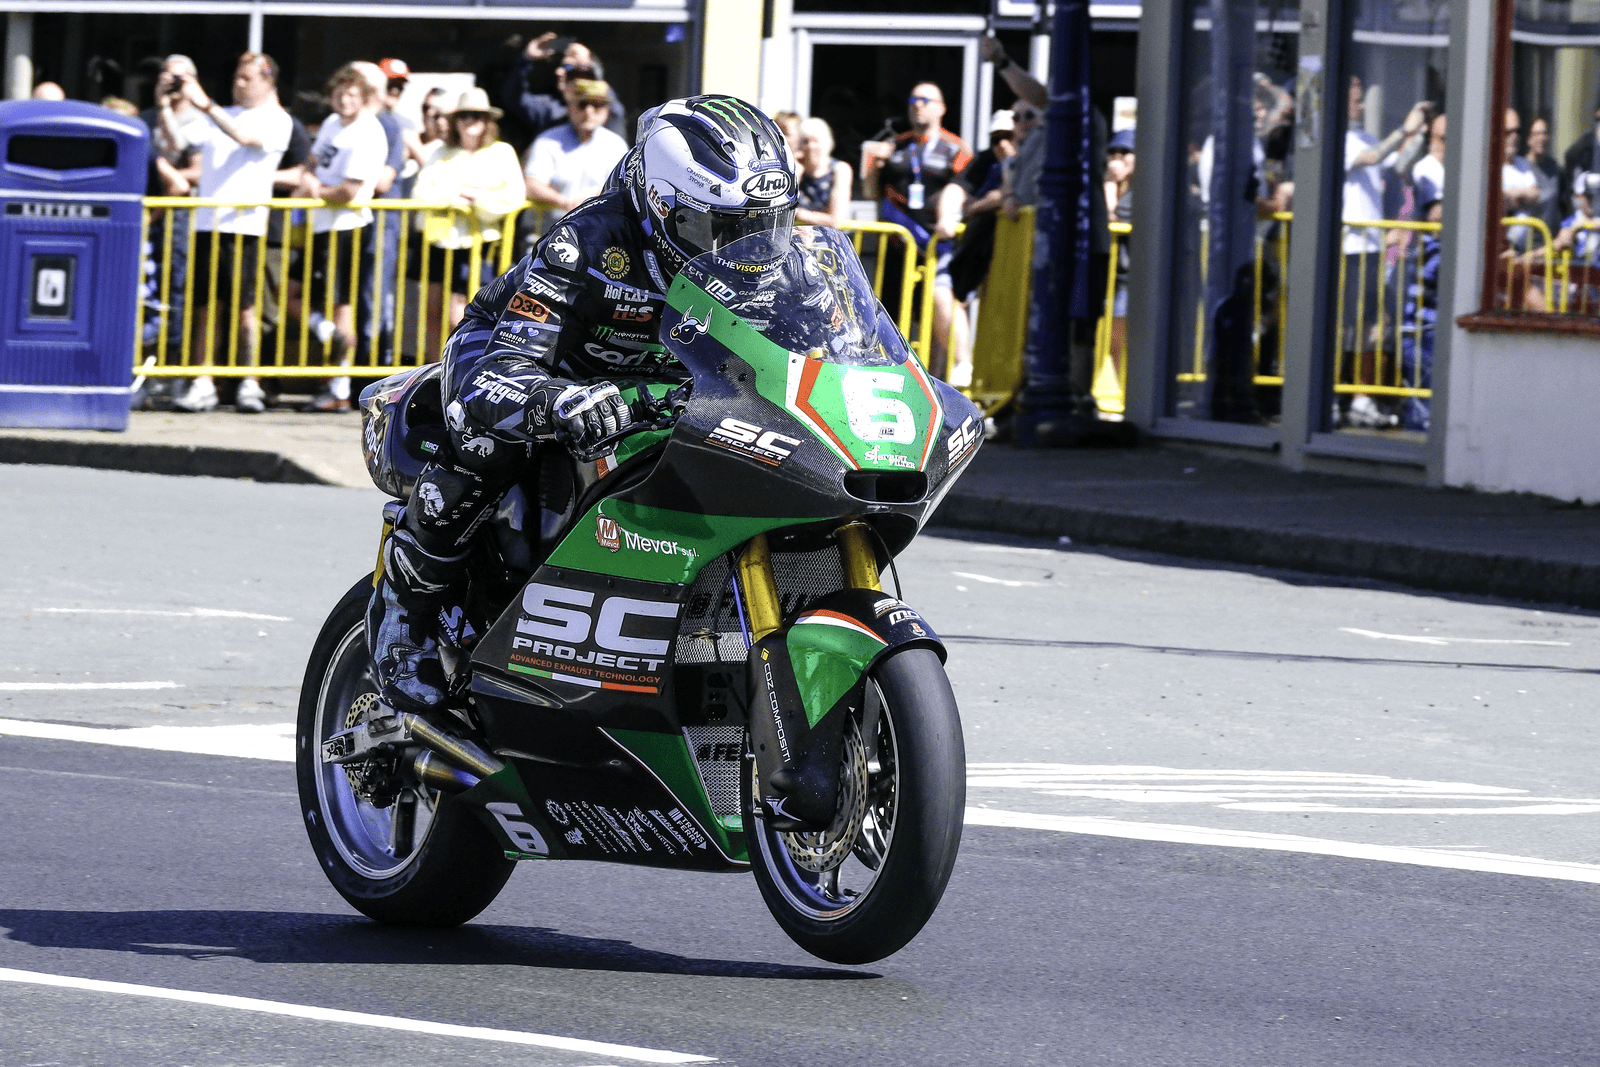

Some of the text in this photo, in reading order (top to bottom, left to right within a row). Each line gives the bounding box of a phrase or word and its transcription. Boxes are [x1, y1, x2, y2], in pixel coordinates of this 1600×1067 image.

[746, 173, 786, 193] Arai
[21, 202, 93, 217] LITTER
[602, 245, 631, 264] AROUND
[841, 369, 917, 446] 6
[708, 432, 787, 461] PROJECT
[713, 417, 802, 457] SC
[947, 414, 977, 461] SC
[624, 531, 678, 555] Mevar
[515, 582, 680, 656] SC
[510, 652, 661, 684] ADVANCED EXHAUST TECHNOLOGY
[512, 636, 666, 672] PROJECT
[768, 691, 791, 764] COMPOSITI
[484, 802, 550, 855] 6
[675, 819, 700, 845] FERRY
[683, 816, 705, 843] TRANS
